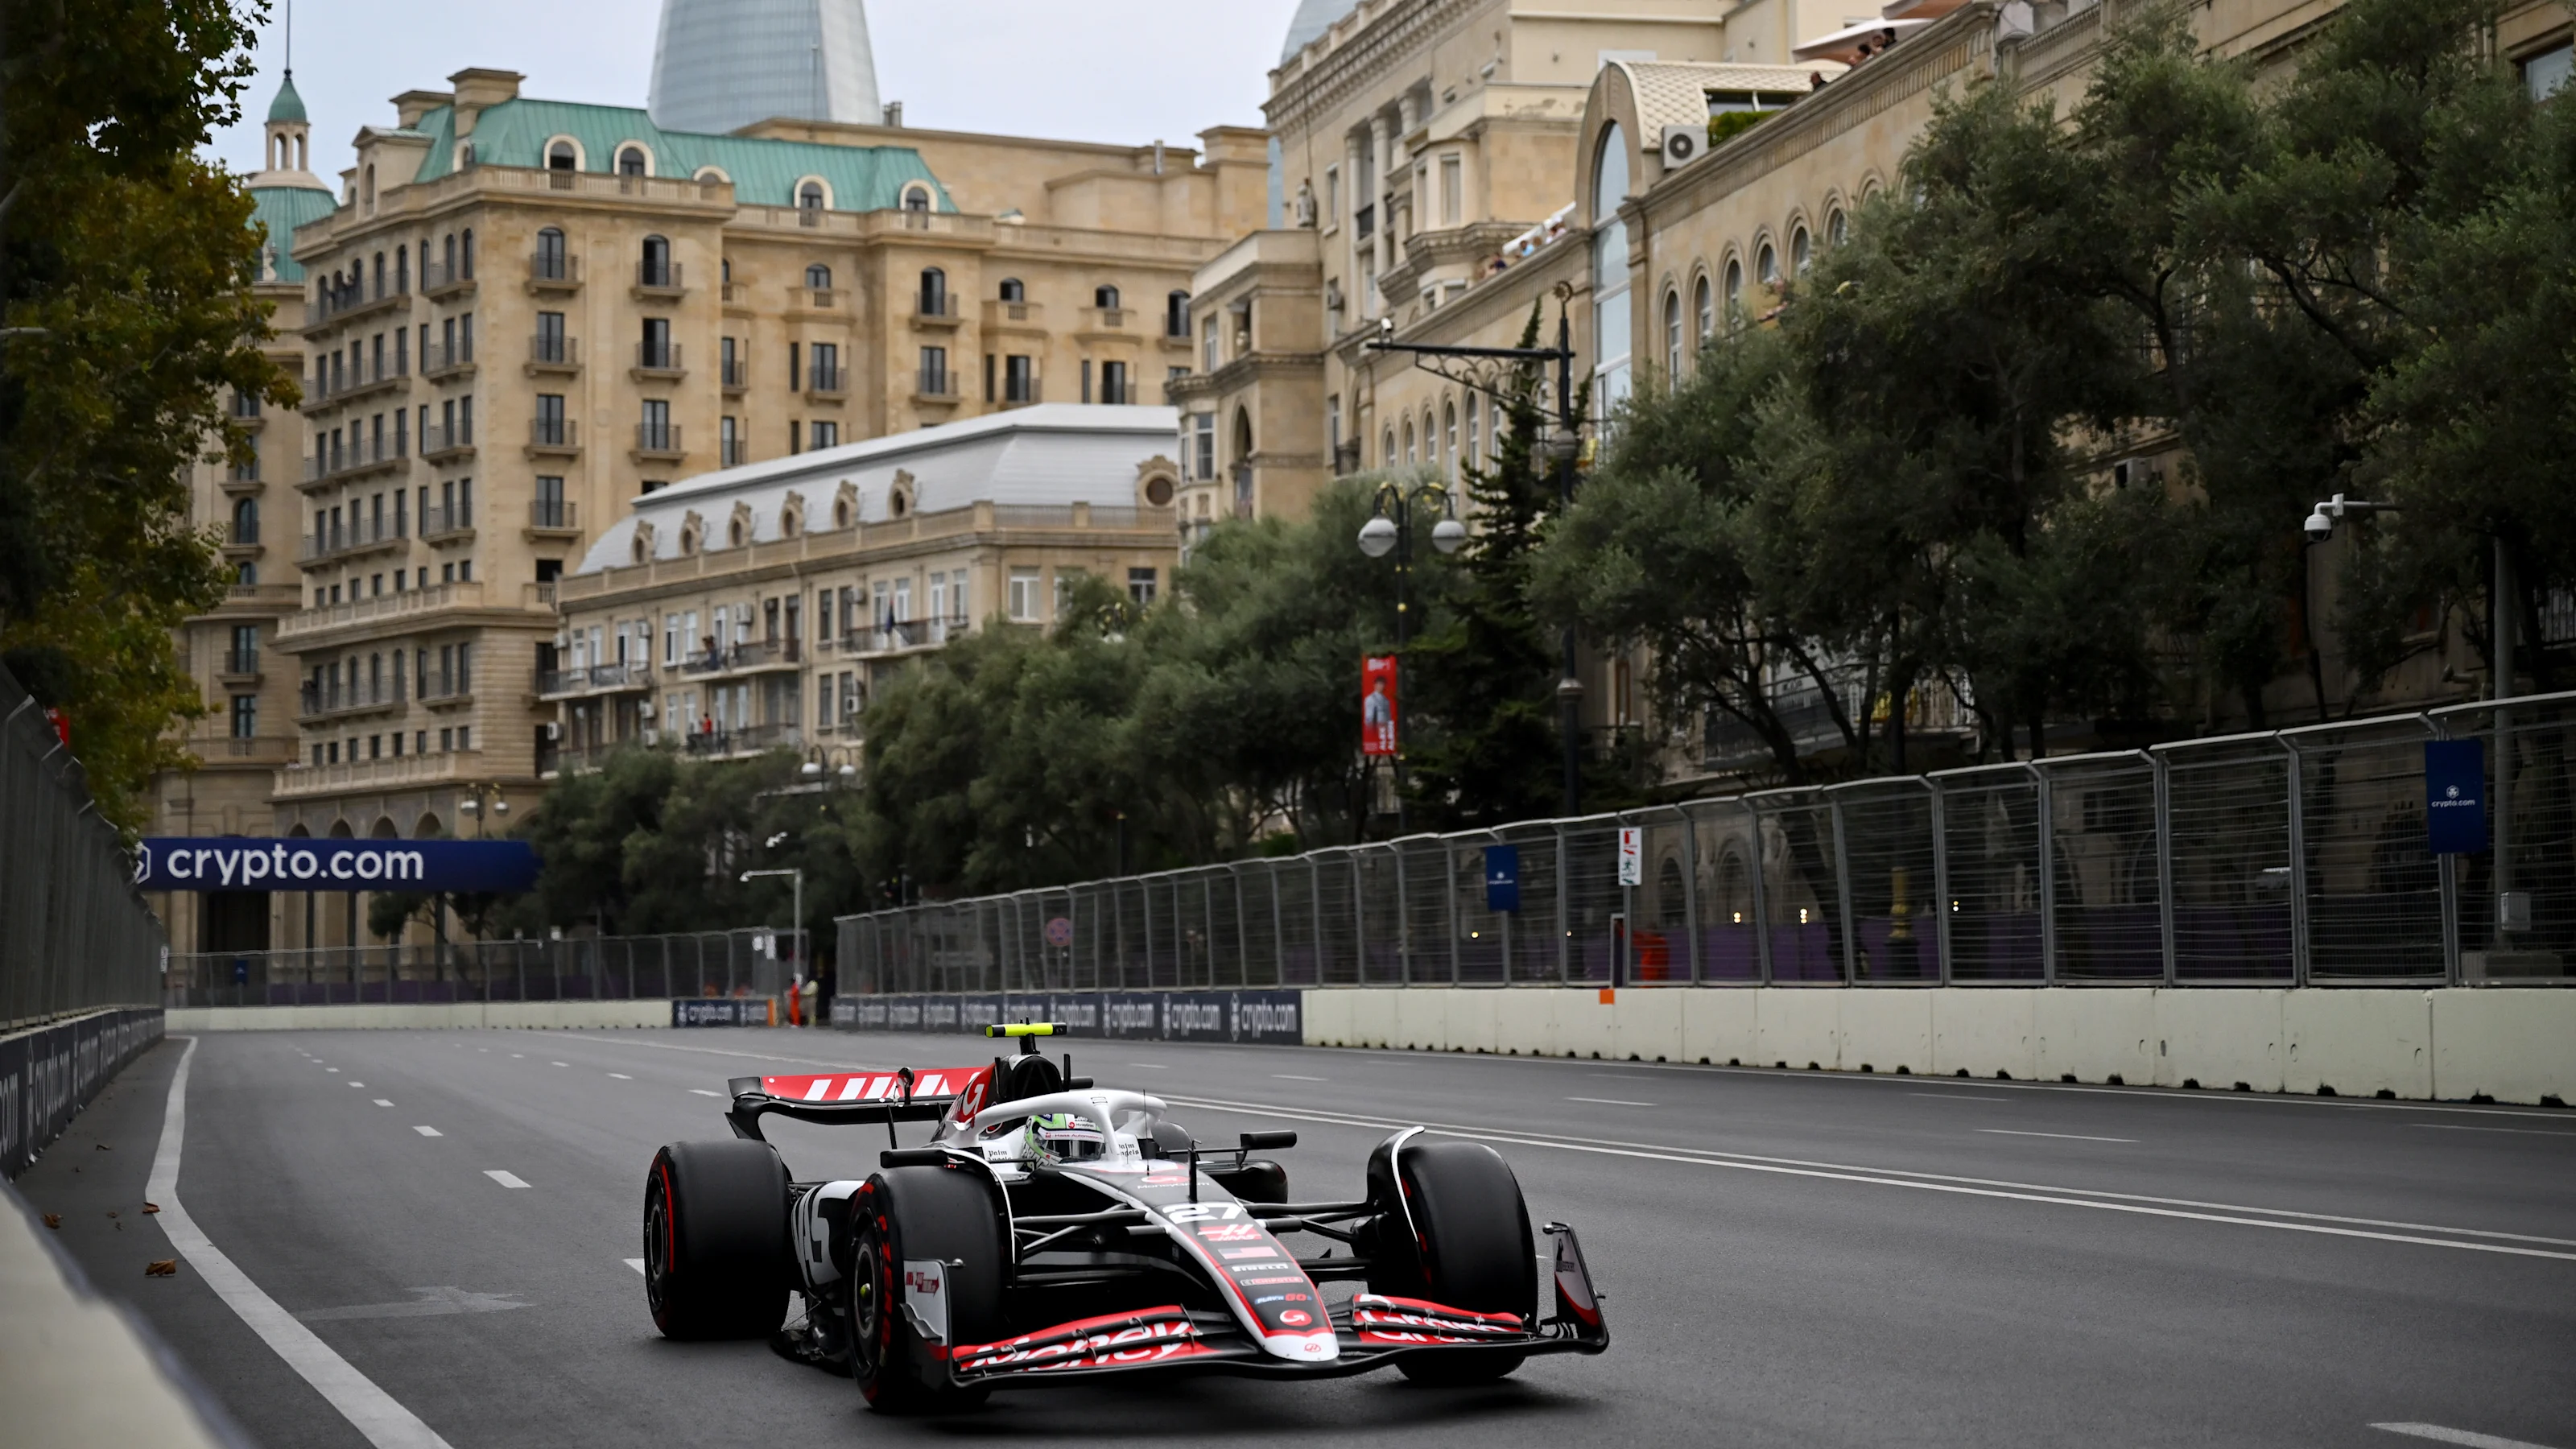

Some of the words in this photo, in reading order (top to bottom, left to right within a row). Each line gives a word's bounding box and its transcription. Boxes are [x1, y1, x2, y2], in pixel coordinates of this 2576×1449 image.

[2431, 799, 2475, 808] crypto.com
[167, 844, 423, 886] crypto.com
[1111, 998, 1154, 1034] crypto.com
[1171, 998, 1221, 1037] crypto.com
[1241, 997, 1297, 1038] crypto.com
[989, 1150, 1008, 1158] Palm
[1117, 1149, 1139, 1157] ngels
[1162, 1202, 1242, 1224] 27
[1232, 1264, 1289, 1272] PIRELLI
[1285, 1293, 1307, 1302] GO
